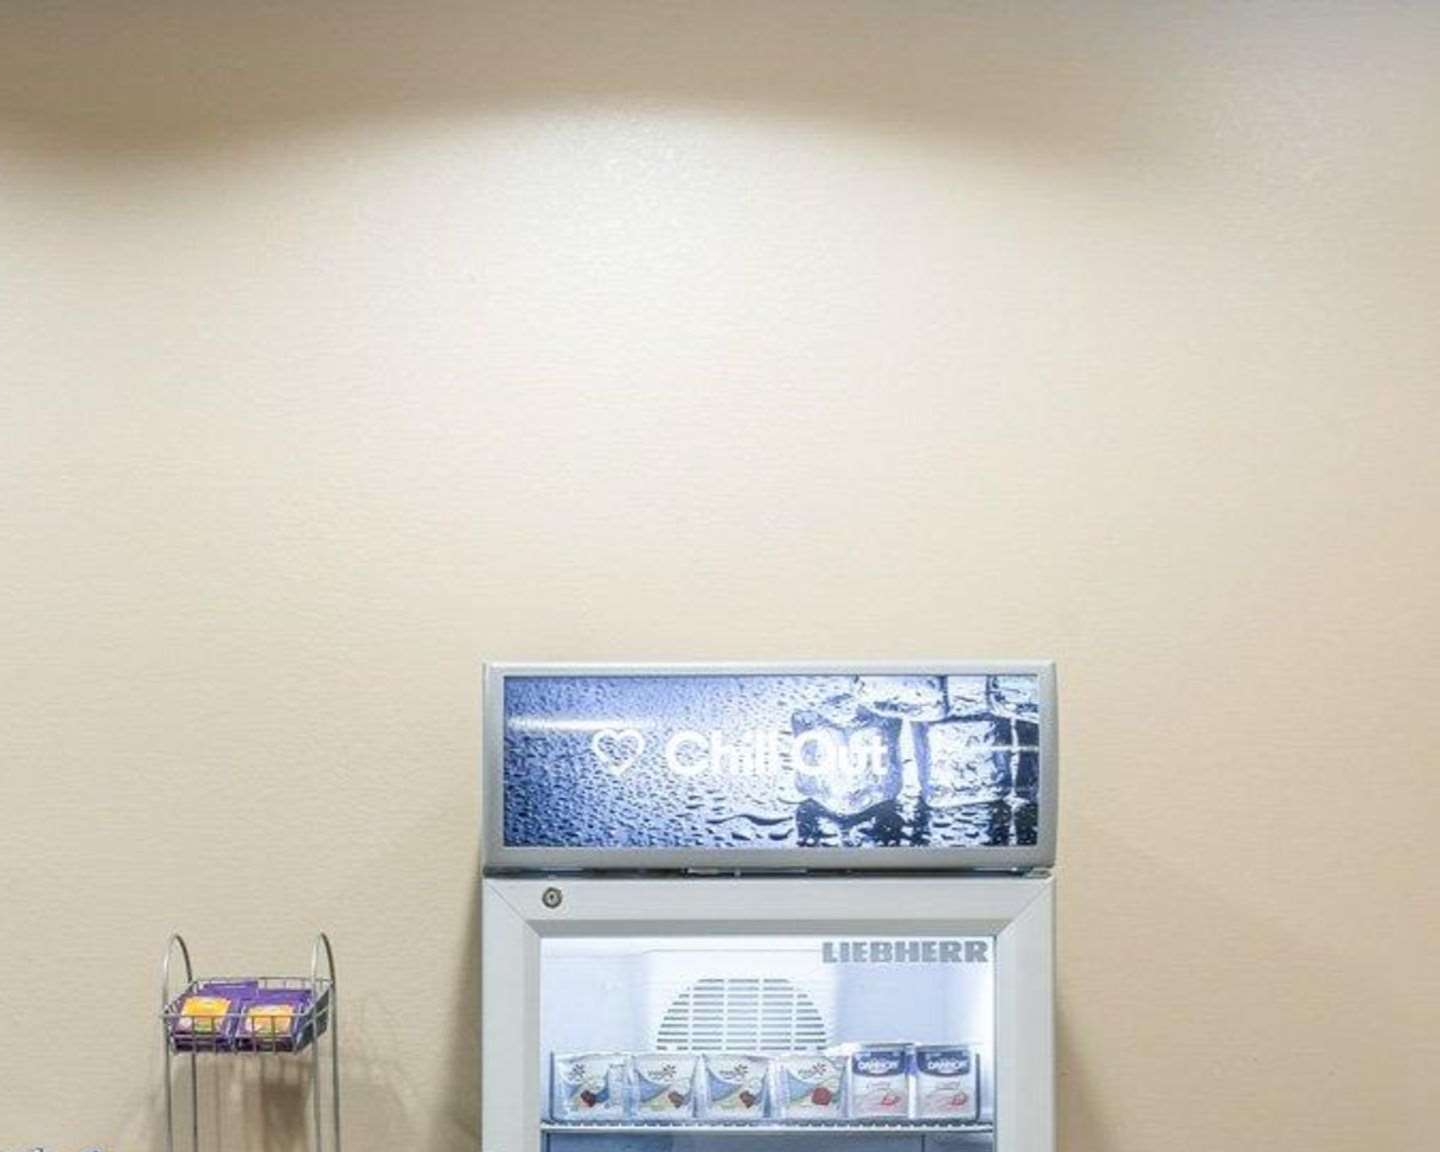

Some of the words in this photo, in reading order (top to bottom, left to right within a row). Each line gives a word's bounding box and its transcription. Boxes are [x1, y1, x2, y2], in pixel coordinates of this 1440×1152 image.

[667, 728, 777, 775] Chill
[794, 728, 888, 775] Out
[822, 941, 989, 963] LIEBHERR
